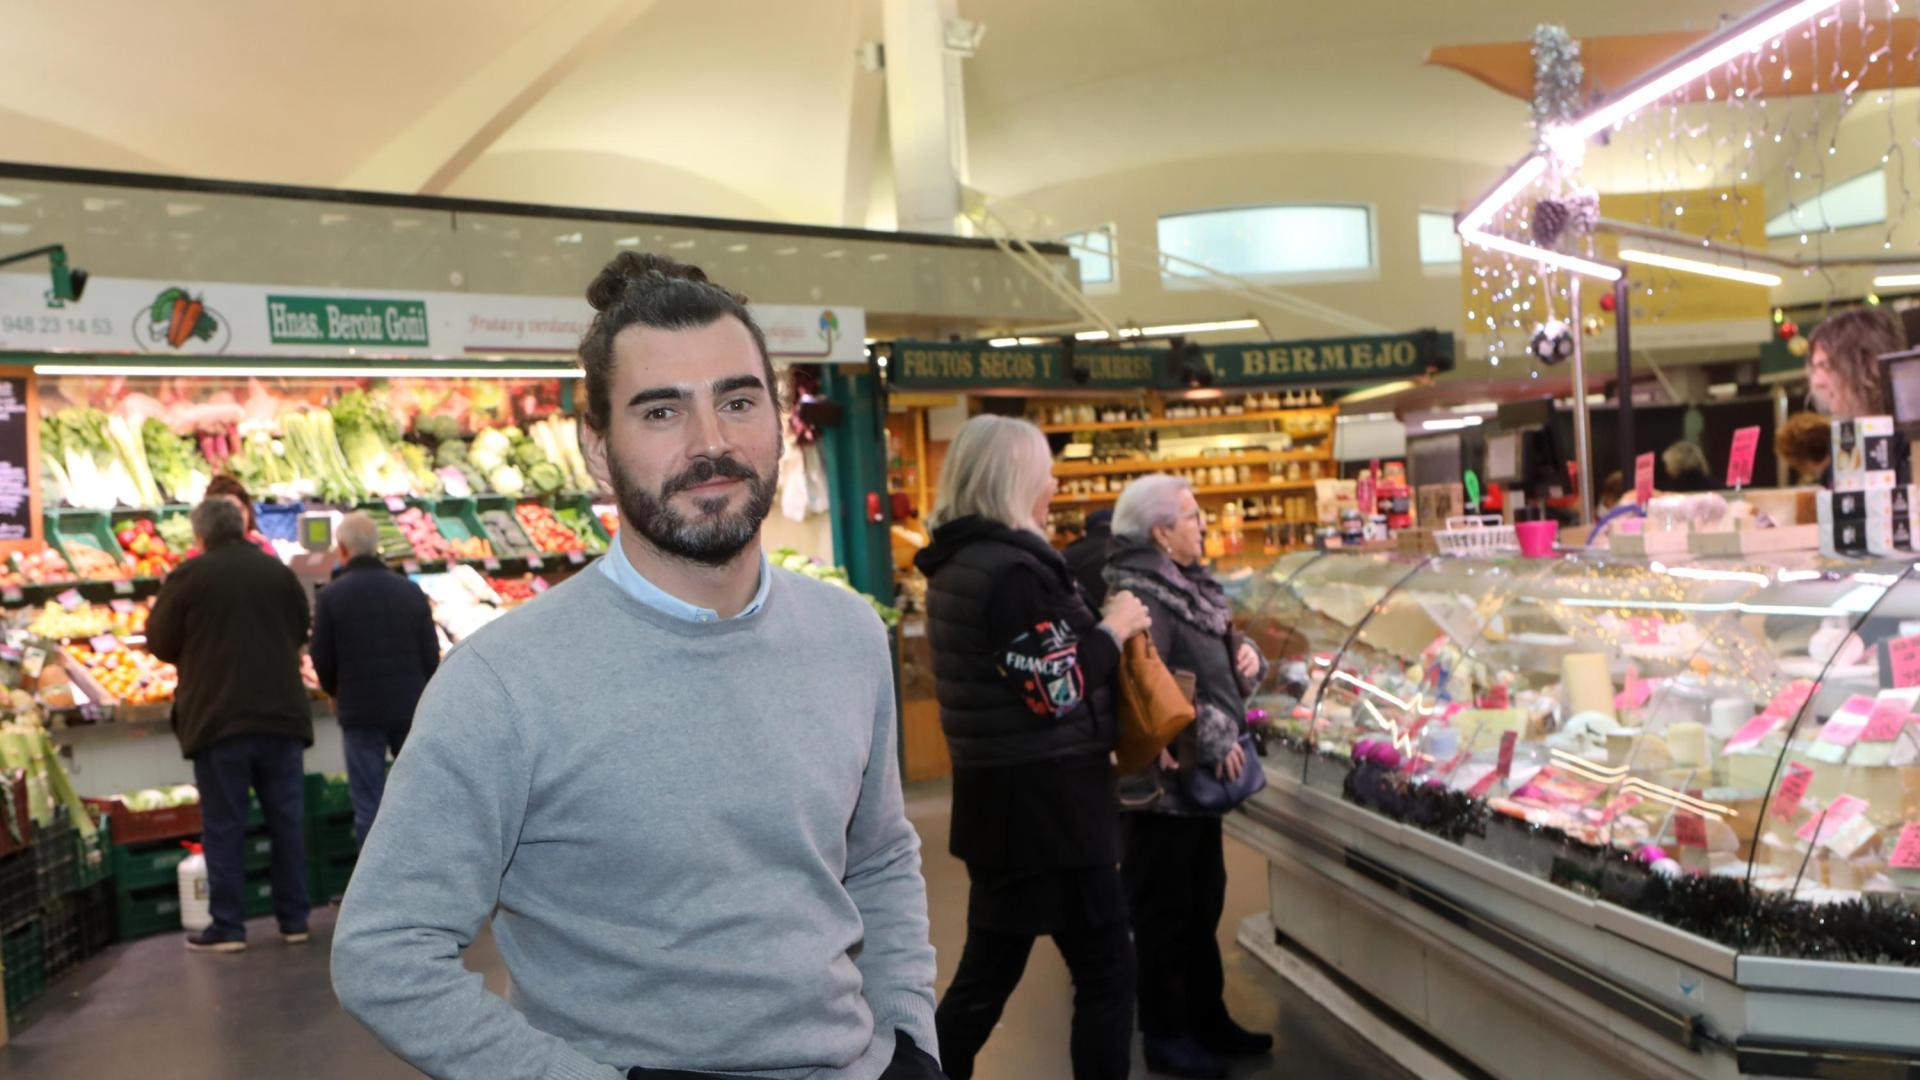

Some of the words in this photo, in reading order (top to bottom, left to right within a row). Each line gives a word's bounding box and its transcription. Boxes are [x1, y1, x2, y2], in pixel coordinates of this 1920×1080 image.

[40, 316, 61, 334] 23
[271, 302, 324, 338] Hnas.
[903, 351, 974, 377] FRUTOS
[979, 352, 1036, 378] SECOS
[1041, 353, 1053, 378] Y
[1242, 340, 1416, 376] BERMEJO
[1006, 651, 1062, 677] FRANCE
